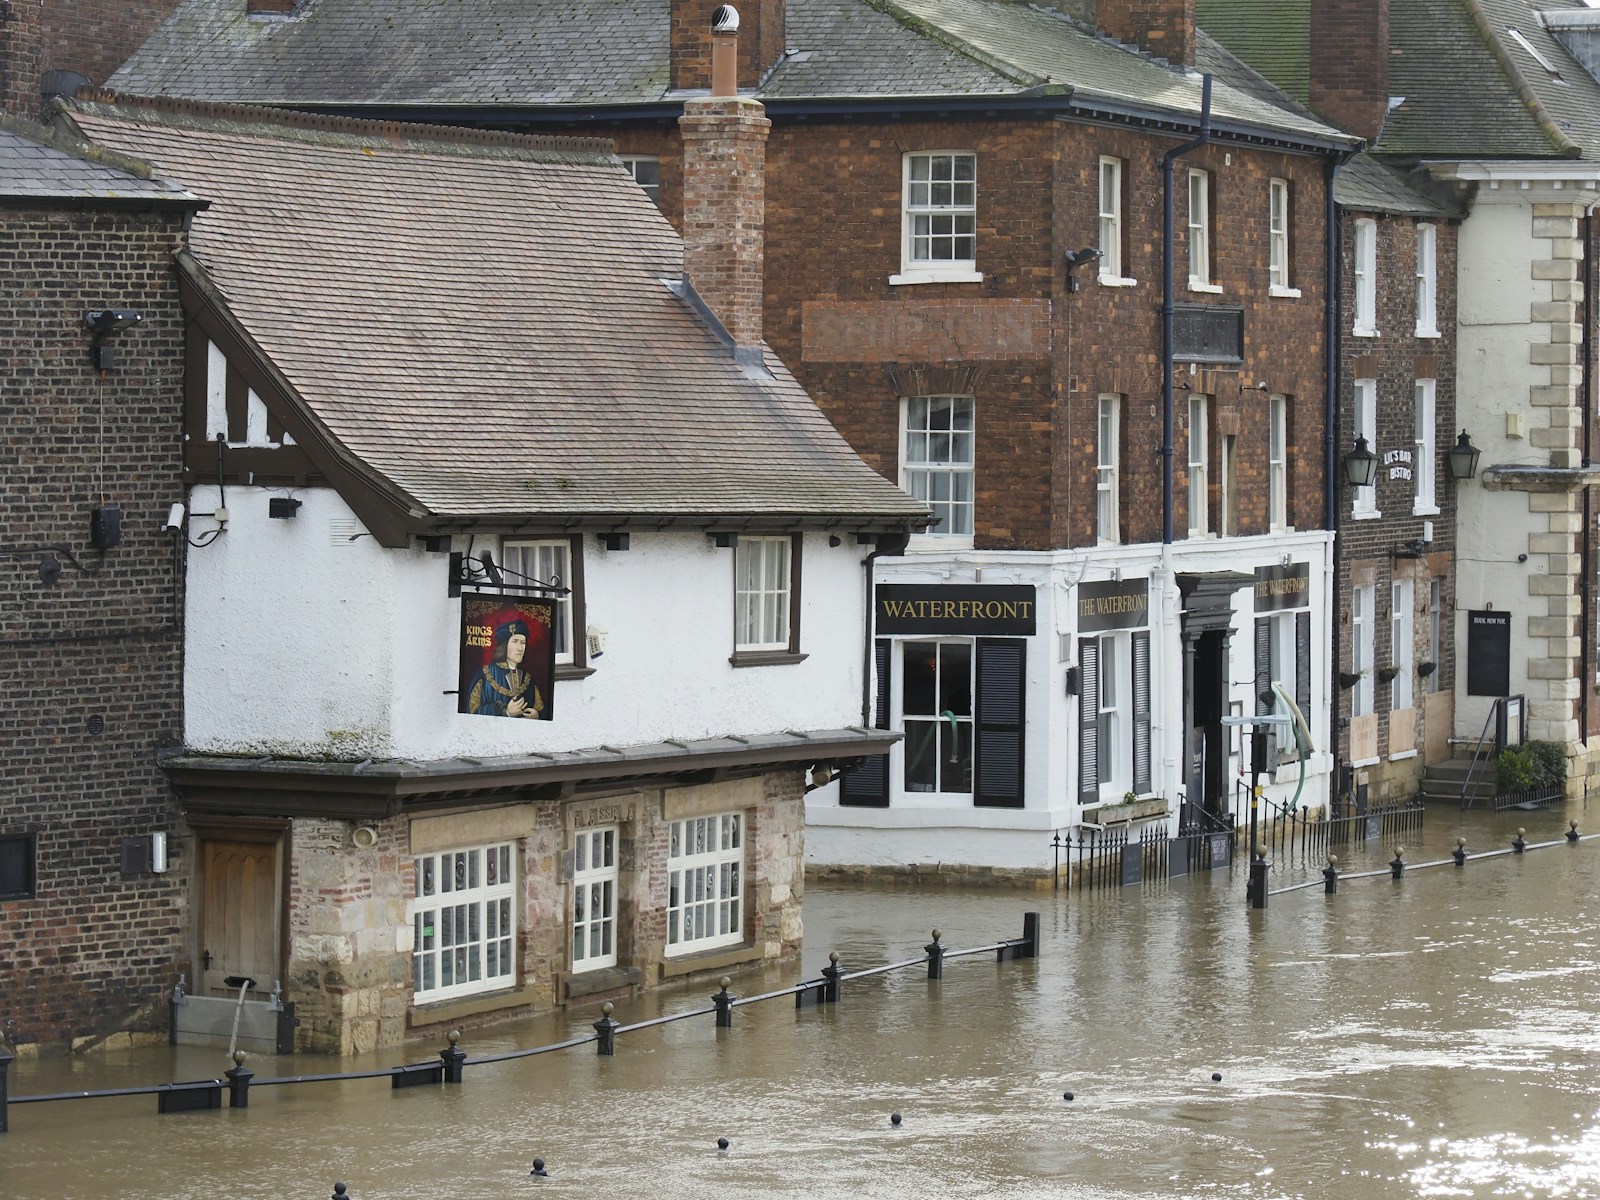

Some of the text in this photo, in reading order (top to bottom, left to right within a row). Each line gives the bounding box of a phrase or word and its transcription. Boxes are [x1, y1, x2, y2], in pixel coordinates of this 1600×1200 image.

[1399, 450, 1412, 463] BAR
[1390, 466, 1412, 480] BISTRO
[1256, 576, 1309, 598] THE WATERFRONT
[883, 600, 1033, 619] WATERFRONT
[1079, 593, 1148, 616] THE WATERFRONT
[1474, 616, 1486, 624] BOOK
[466, 625, 493, 637] KINGS
[465, 636, 492, 648] ARMS
